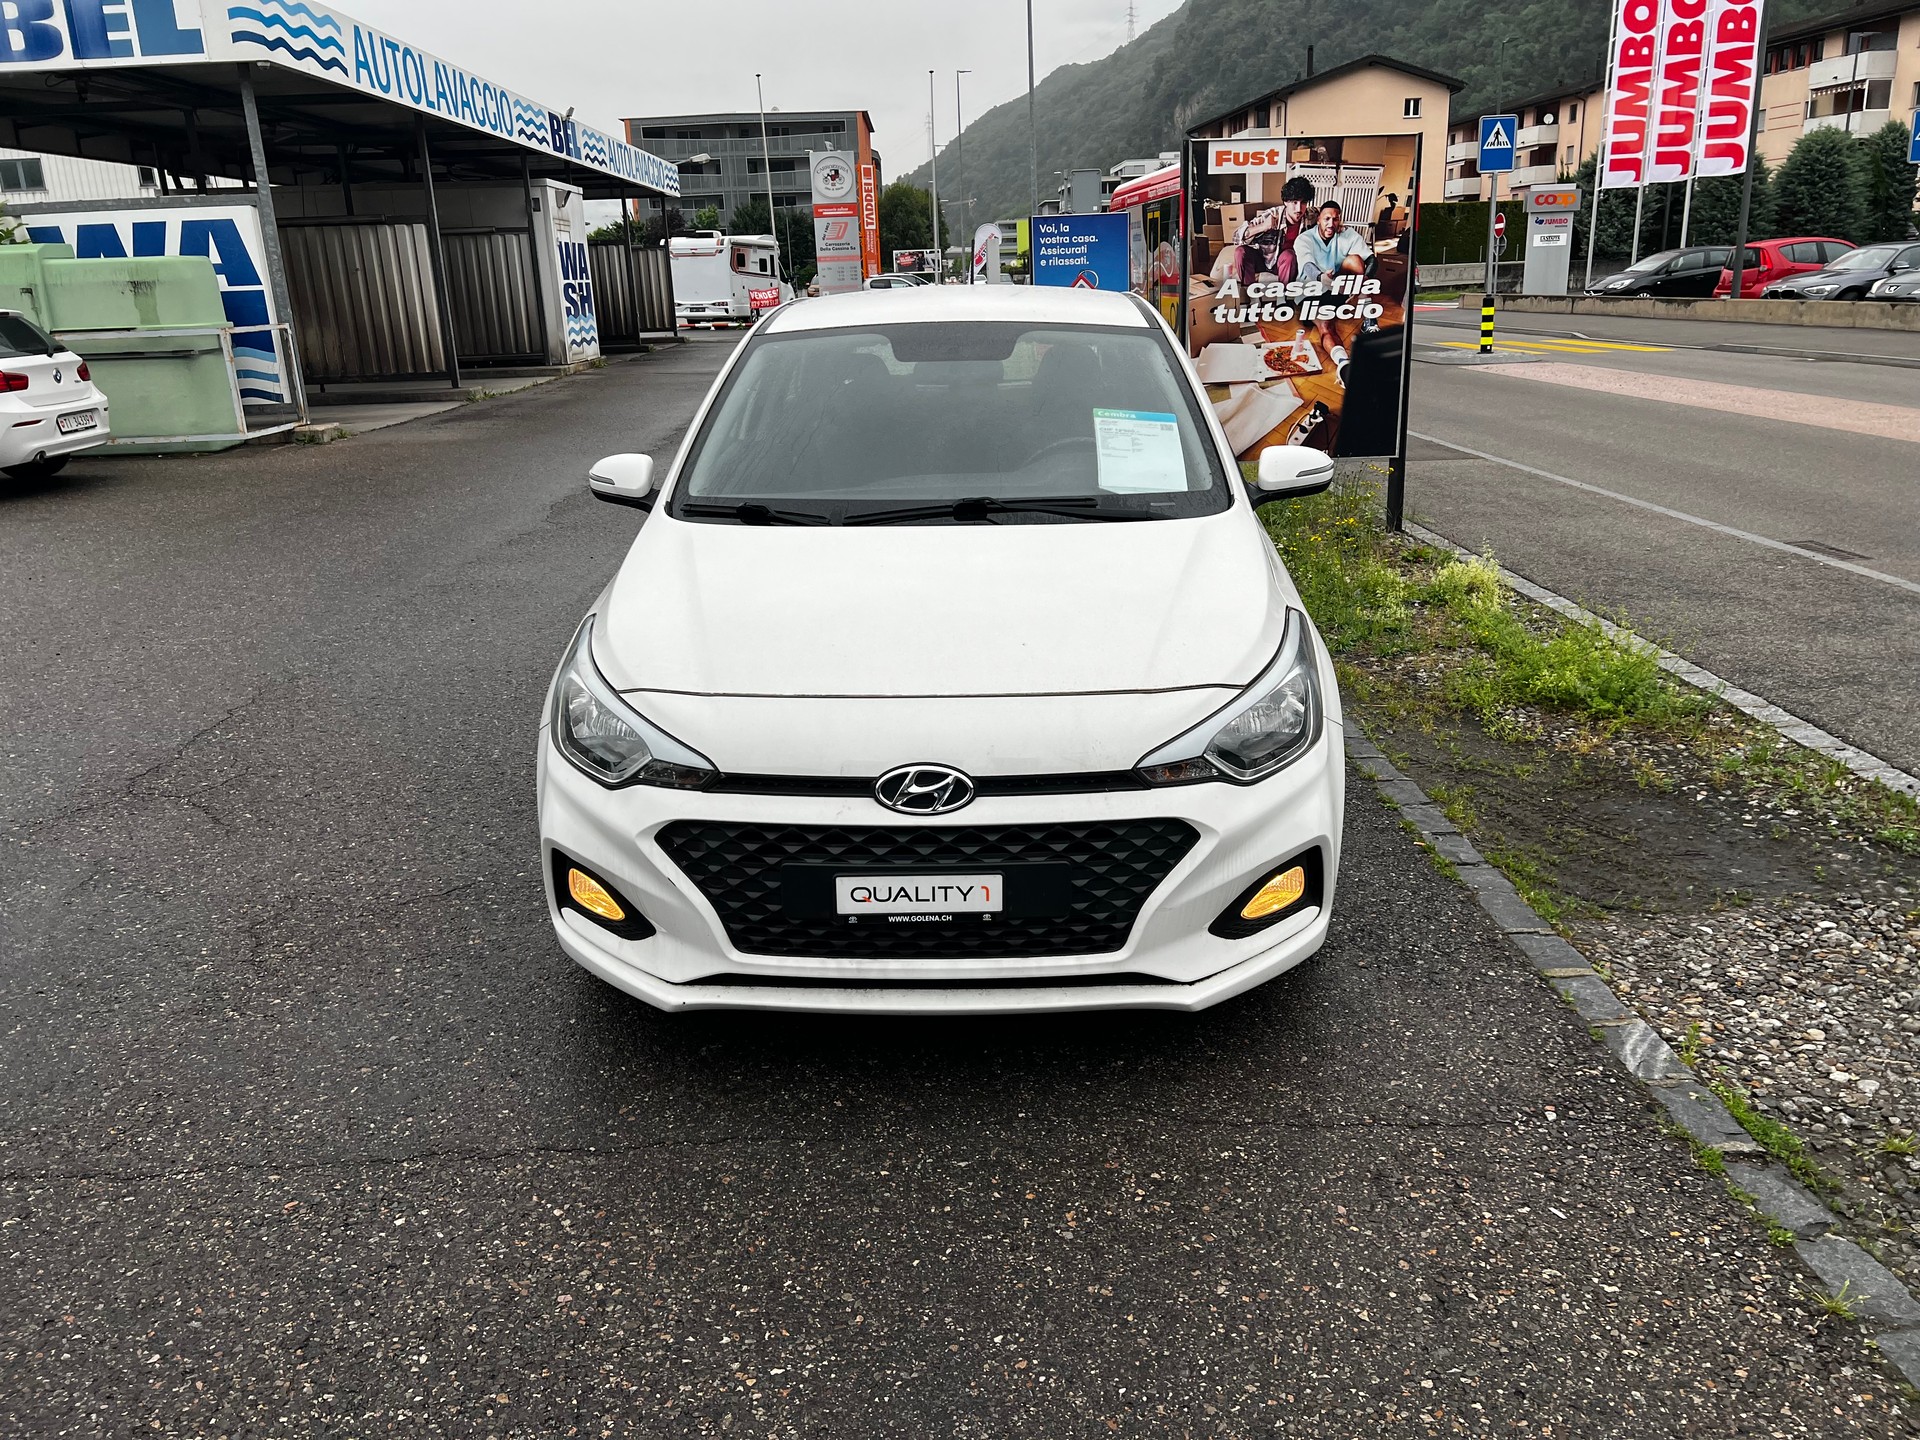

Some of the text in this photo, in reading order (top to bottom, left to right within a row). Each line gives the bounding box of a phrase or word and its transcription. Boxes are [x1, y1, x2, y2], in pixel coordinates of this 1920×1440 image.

[0, 0, 204, 62] BEL
[1609, 0, 1658, 182] JUMBO
[1704, 0, 1757, 169] JUMB
[353, 24, 665, 189] AUTOLAVACCIO BEL AUTOLAVACCIO
[1214, 148, 1280, 167] Fust
[863, 182, 875, 228] TADDEI
[1534, 192, 1577, 208] coop
[1039, 223, 1070, 234] Voi, la
[1039, 234, 1099, 244] vostra casa.
[1040, 245, 1088, 256] Assicurati
[557, 240, 590, 281] WA
[1049, 255, 1090, 266] rilassati.
[1215, 275, 1381, 299] A casa fila
[563, 281, 594, 318] SH
[1213, 298, 1384, 324] tutto liscio
[64, 418, 73, 428] TI
[1097, 410, 1137, 419] Cembra
[850, 886, 990, 903] QUALITY 1
[888, 915, 953, 923] WWW.GOLENA.CH
